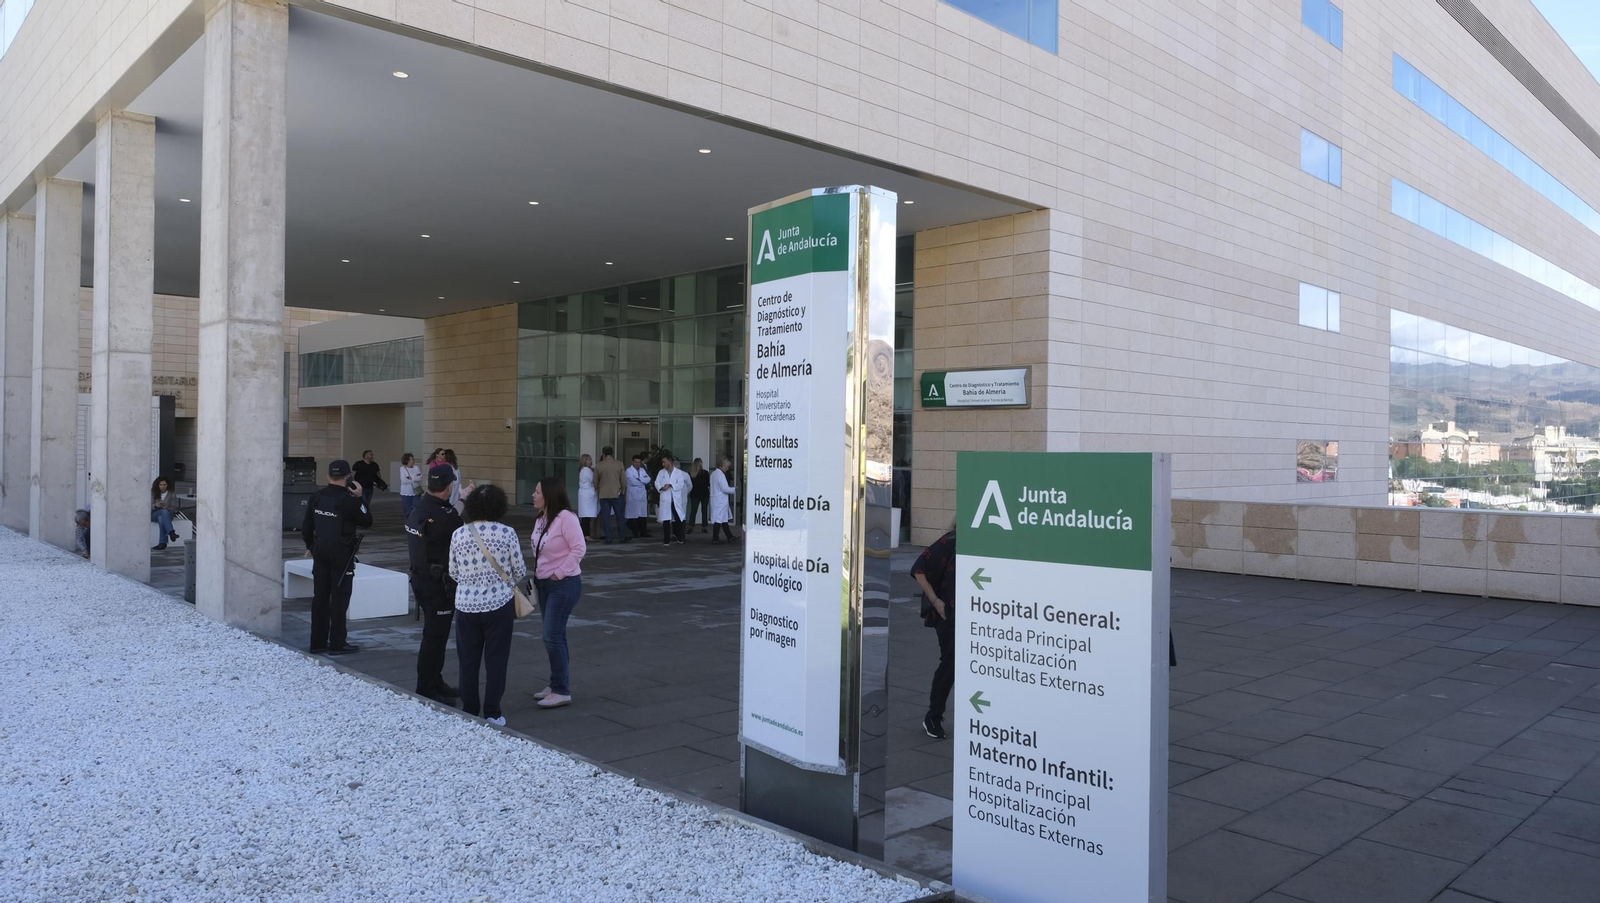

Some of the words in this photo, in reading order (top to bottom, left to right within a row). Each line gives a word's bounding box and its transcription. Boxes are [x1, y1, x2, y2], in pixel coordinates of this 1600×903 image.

[778, 226, 800, 240] Junta
[778, 243, 787, 255] de
[788, 233, 837, 252] Andalucía
[758, 295, 781, 307] Centro
[783, 291, 792, 303] de
[758, 306, 800, 323] Diagnóstico
[801, 306, 806, 318] y
[758, 321, 802, 337] Tratamiento
[757, 340, 785, 358] Bahía
[757, 364, 768, 379] de
[771, 359, 812, 378] Almería
[756, 389, 779, 400] Hospital
[756, 400, 791, 410] Universitario
[756, 412, 796, 421] Torrecárdenas
[755, 435, 798, 448] Consultas
[755, 455, 792, 468] Externas
[754, 494, 790, 510] Hospital
[793, 496, 804, 510] de
[807, 495, 830, 511] Día
[1018, 486, 1067, 504] Junta
[754, 512, 784, 528] Médico
[1018, 507, 1038, 524] de
[1042, 508, 1132, 530] Andalucía
[754, 551, 789, 570] Hospital
[792, 556, 803, 571] de
[806, 557, 829, 573] Día
[753, 570, 802, 592] Oncológico
[750, 608, 798, 631] Diagnostico
[971, 596, 1038, 620] Hospital
[1044, 605, 1120, 630] General:
[750, 626, 763, 638] por
[765, 628, 796, 649] imagen
[970, 622, 1022, 642] Entrada
[1027, 630, 1091, 653] Principal
[970, 641, 1077, 671] Hospitalización
[970, 660, 1036, 684] Consultas
[1041, 672, 1104, 696] Externas
[970, 718, 1037, 748] Hospital
[969, 741, 1037, 771] Materno
[1043, 758, 1114, 790] Infantil:
[969, 766, 1021, 792] Entrada
[1026, 781, 1090, 811] Principal
[969, 785, 1076, 827] Hospitalización
[968, 805, 1035, 835] Consultas
[1040, 824, 1103, 856] Externas
